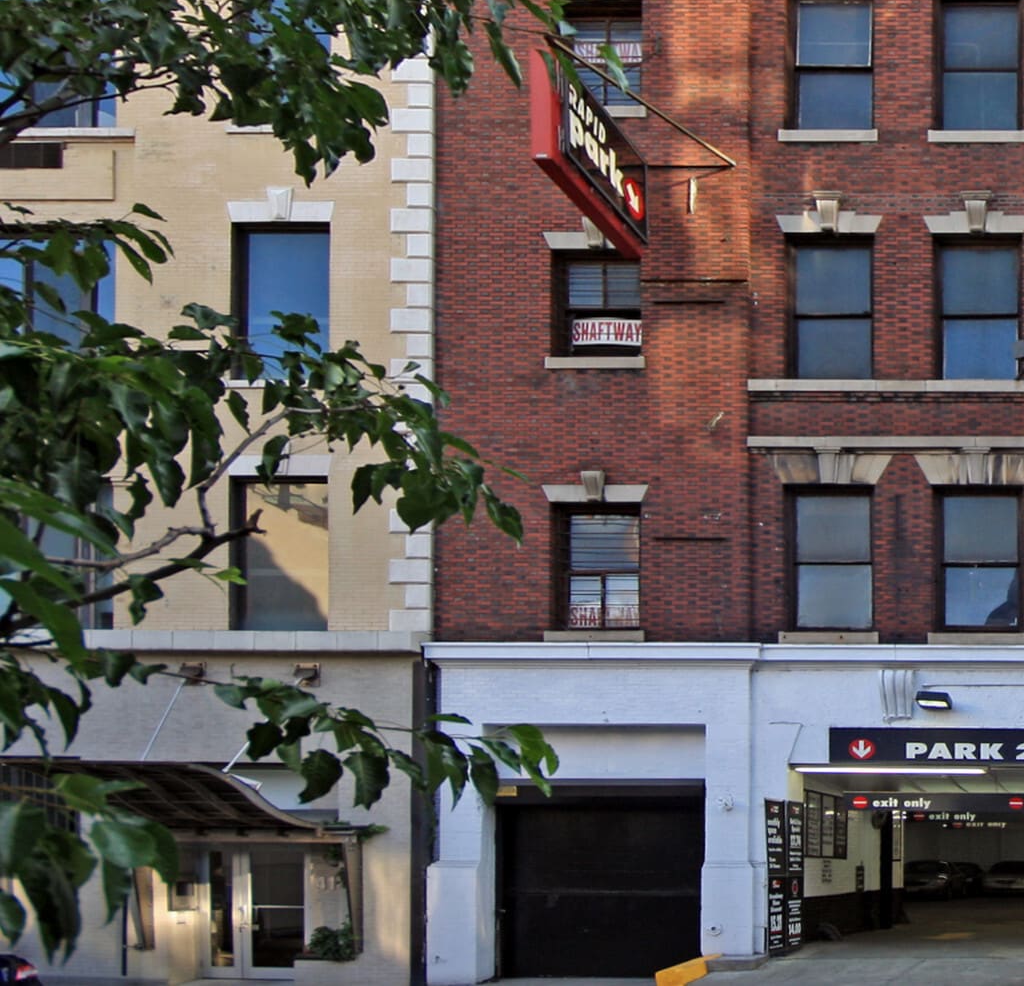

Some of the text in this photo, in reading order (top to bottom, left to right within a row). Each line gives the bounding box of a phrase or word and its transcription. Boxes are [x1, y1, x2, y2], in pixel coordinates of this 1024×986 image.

[569, 84, 606, 144] RAPID
[572, 321, 642, 342] SHAFTWAY
[905, 742, 1004, 760] PARK
[872, 797, 931, 810] exit only
[928, 812, 976, 822] exit only
